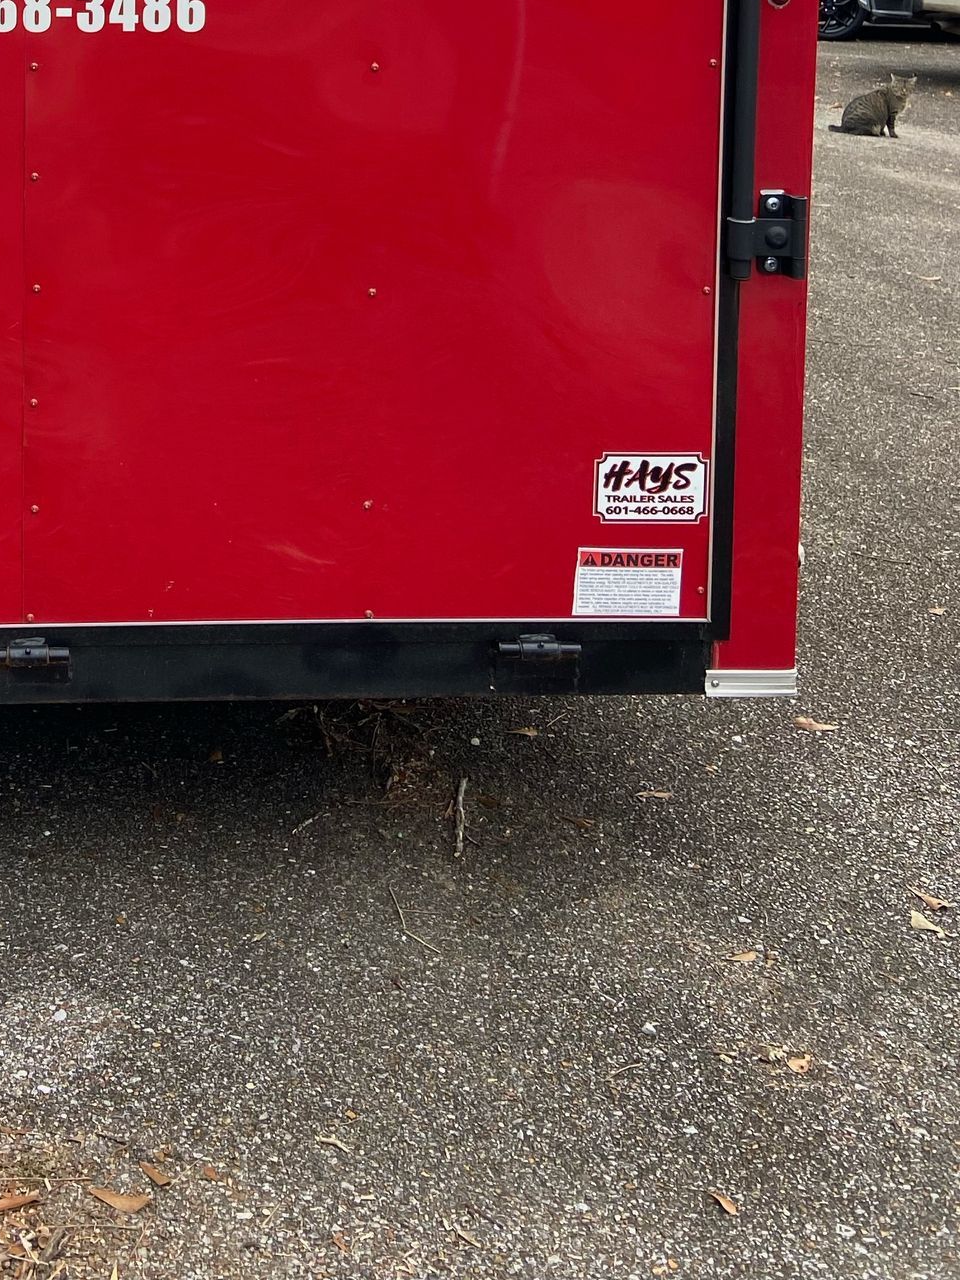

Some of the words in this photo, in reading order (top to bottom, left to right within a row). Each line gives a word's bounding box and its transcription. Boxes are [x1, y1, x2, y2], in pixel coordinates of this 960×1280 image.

[605, 495, 655, 503] TRAILER
[657, 495, 695, 503] SALES
[605, 506, 695, 515] 601-466-0668
[600, 552, 678, 567] DANGER
